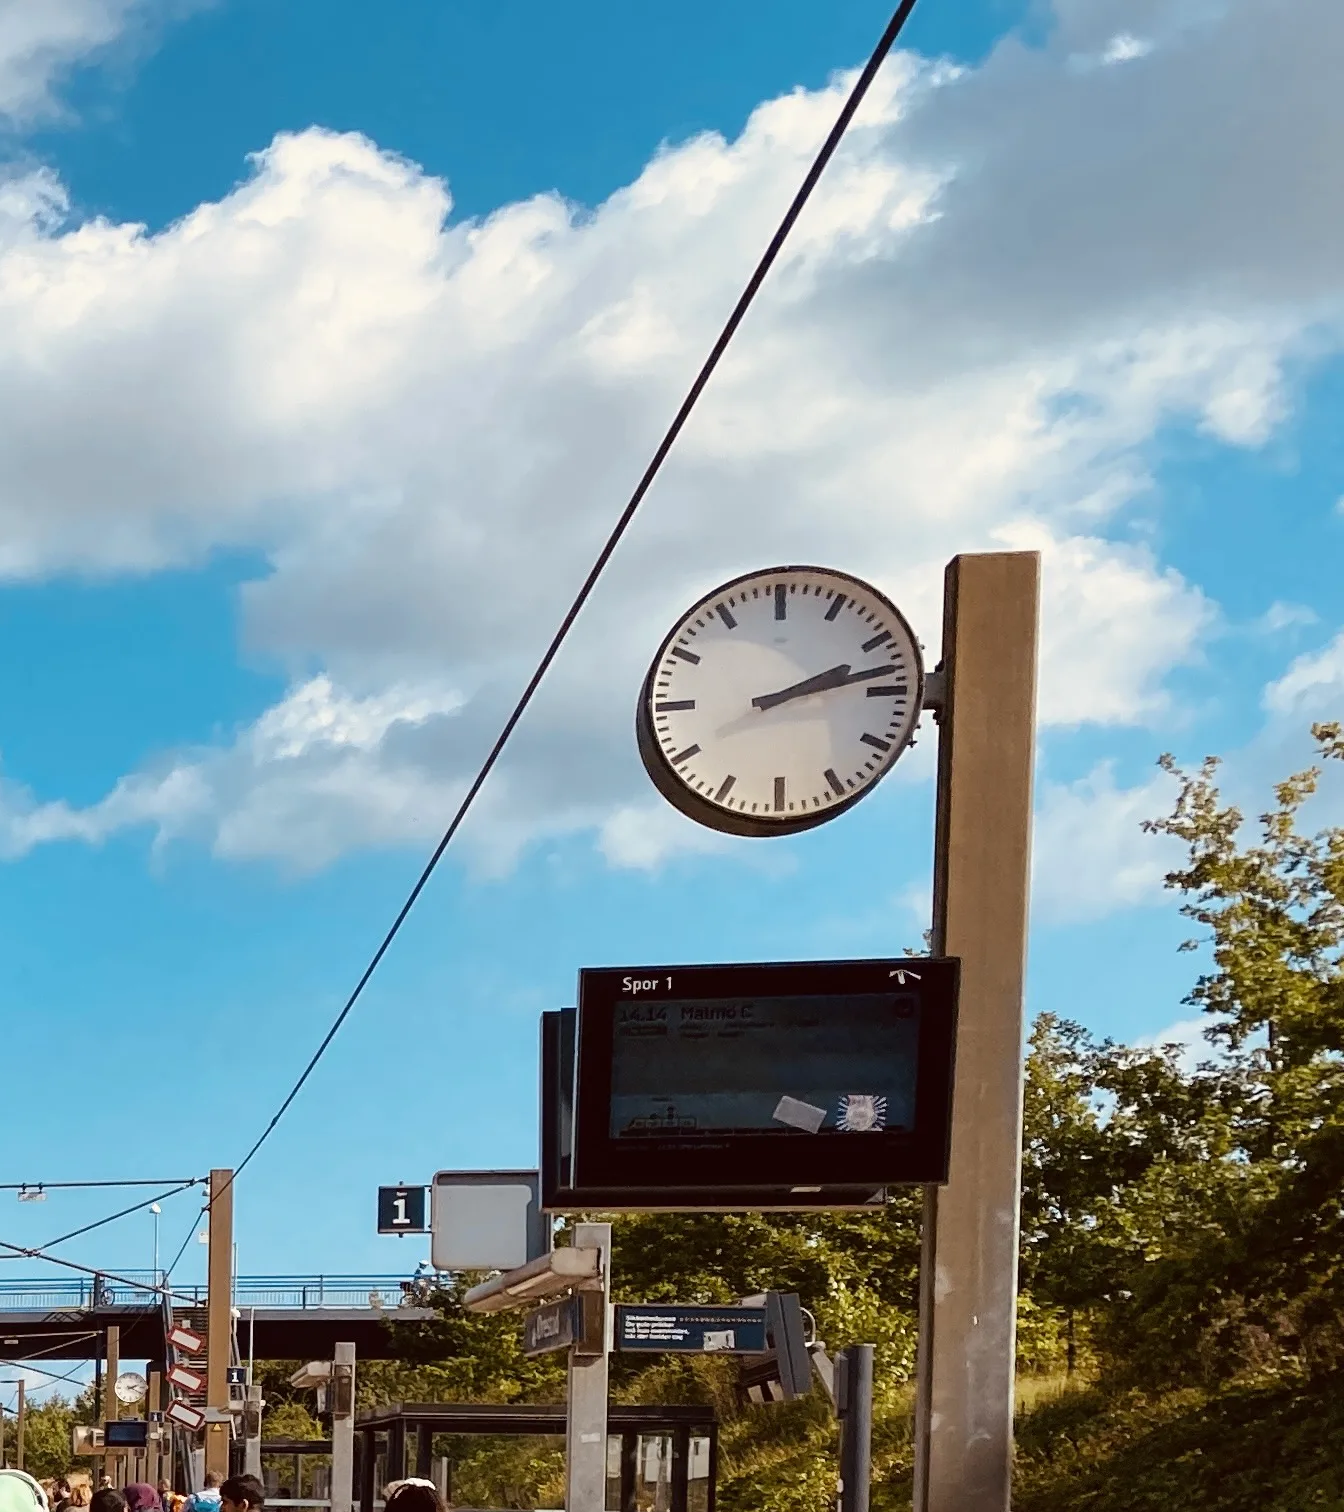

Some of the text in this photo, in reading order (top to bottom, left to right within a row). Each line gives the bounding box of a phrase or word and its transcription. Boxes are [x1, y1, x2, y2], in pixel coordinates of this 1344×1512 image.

[622, 976, 672, 995] Spor 1
[393, 1199, 410, 1224] 1
[231, 1371, 240, 1382] 1
